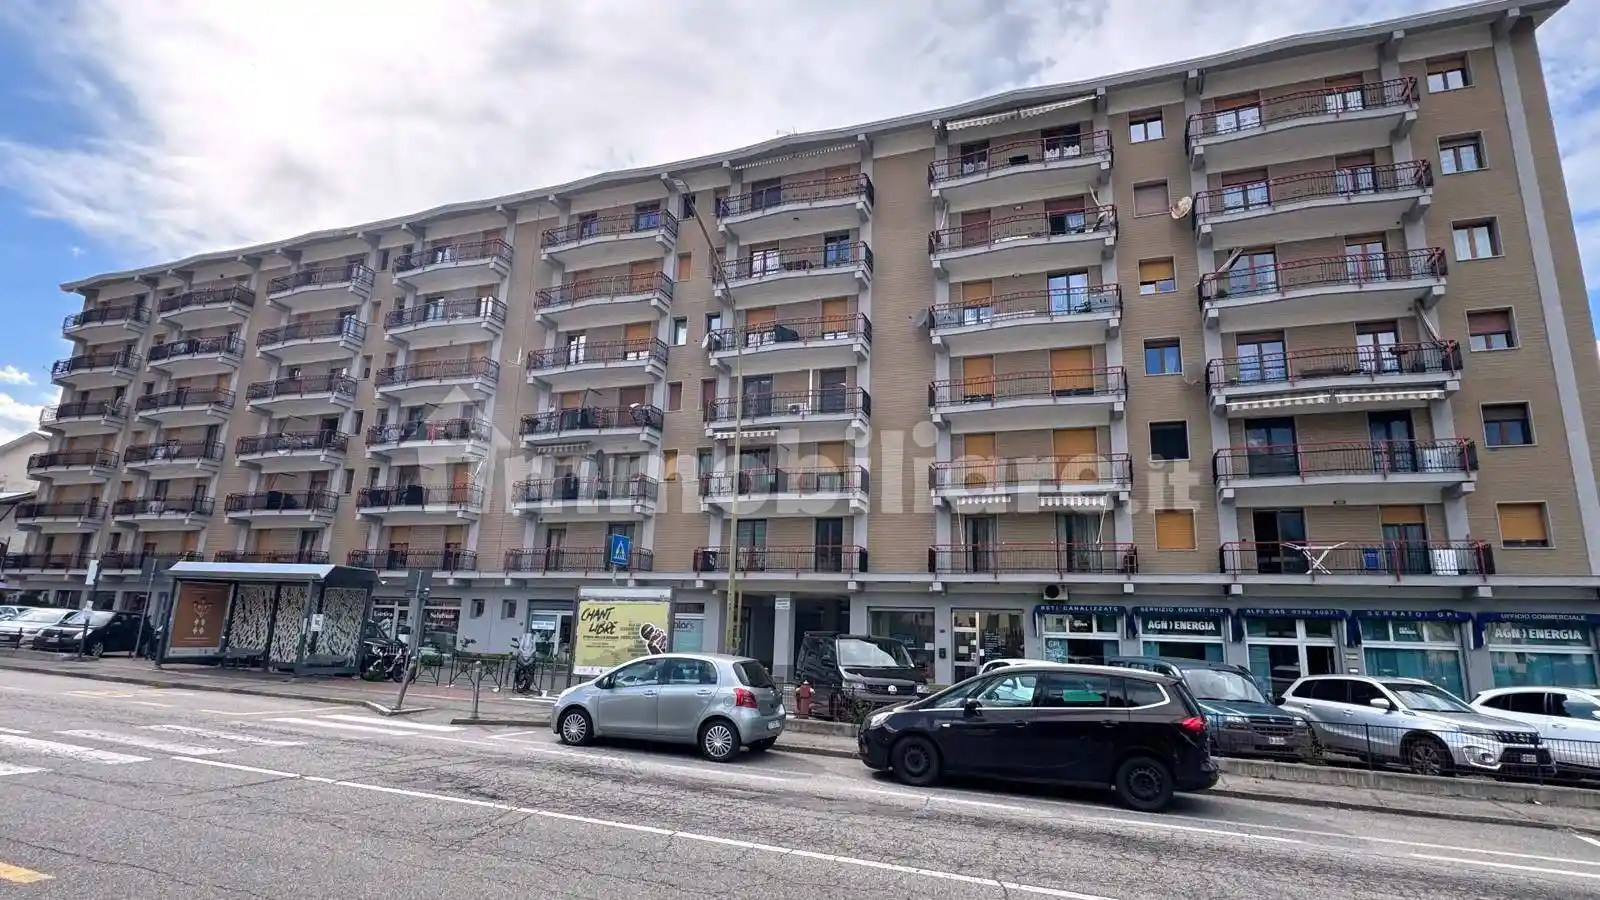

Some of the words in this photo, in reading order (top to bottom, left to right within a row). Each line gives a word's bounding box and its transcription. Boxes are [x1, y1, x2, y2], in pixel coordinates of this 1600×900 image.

[581, 607, 615, 622] CHANT
[1531, 613, 1587, 621] COMMERCIALE
[1147, 620, 1168, 630] AGN
[1174, 621, 1216, 631] ENERGIA
[1494, 628, 1522, 638] AGN
[1529, 629, 1583, 640] ENERGIA
